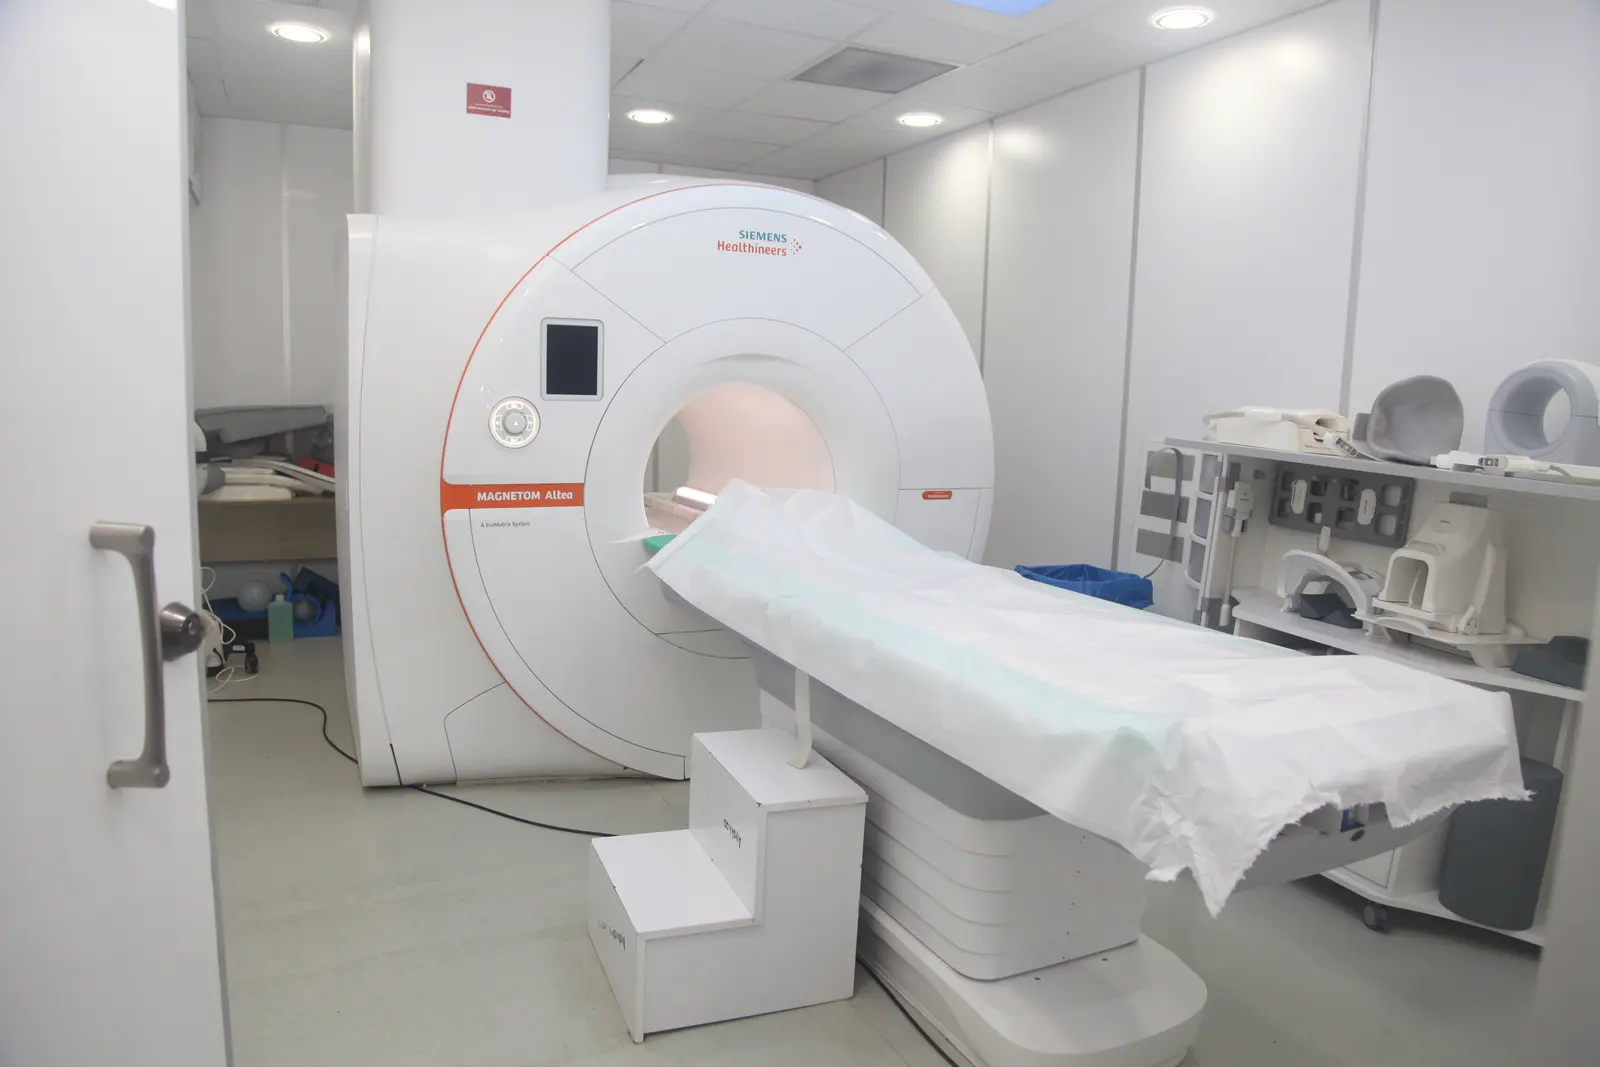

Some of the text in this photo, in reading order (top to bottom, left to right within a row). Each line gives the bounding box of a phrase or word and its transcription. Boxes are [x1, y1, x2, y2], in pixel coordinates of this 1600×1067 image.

[739, 230, 787, 243] SIEMENS
[717, 240, 787, 256] Healthineers
[477, 490, 573, 501] MAGNETOM Altea
